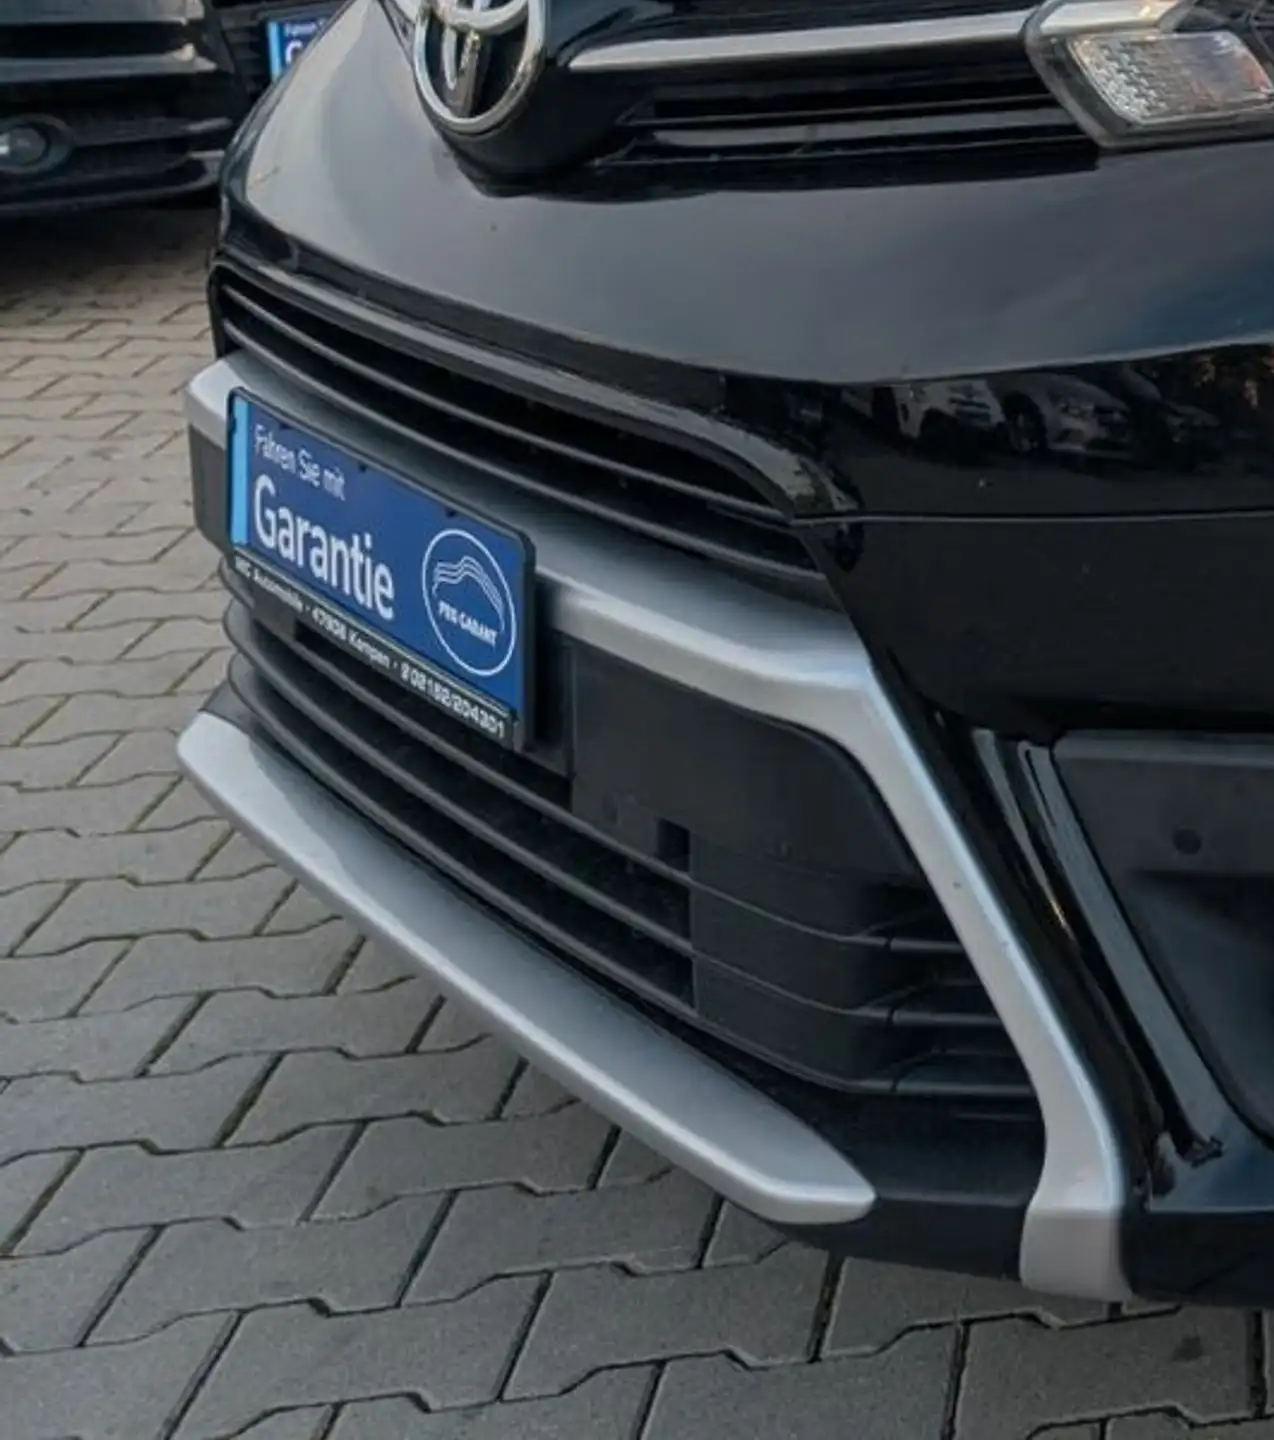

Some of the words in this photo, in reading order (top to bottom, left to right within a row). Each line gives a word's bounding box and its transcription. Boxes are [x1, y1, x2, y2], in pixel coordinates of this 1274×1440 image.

[298, 448, 321, 488] Sie
[323, 466, 346, 502] mit
[253, 475, 396, 622] Garantie
